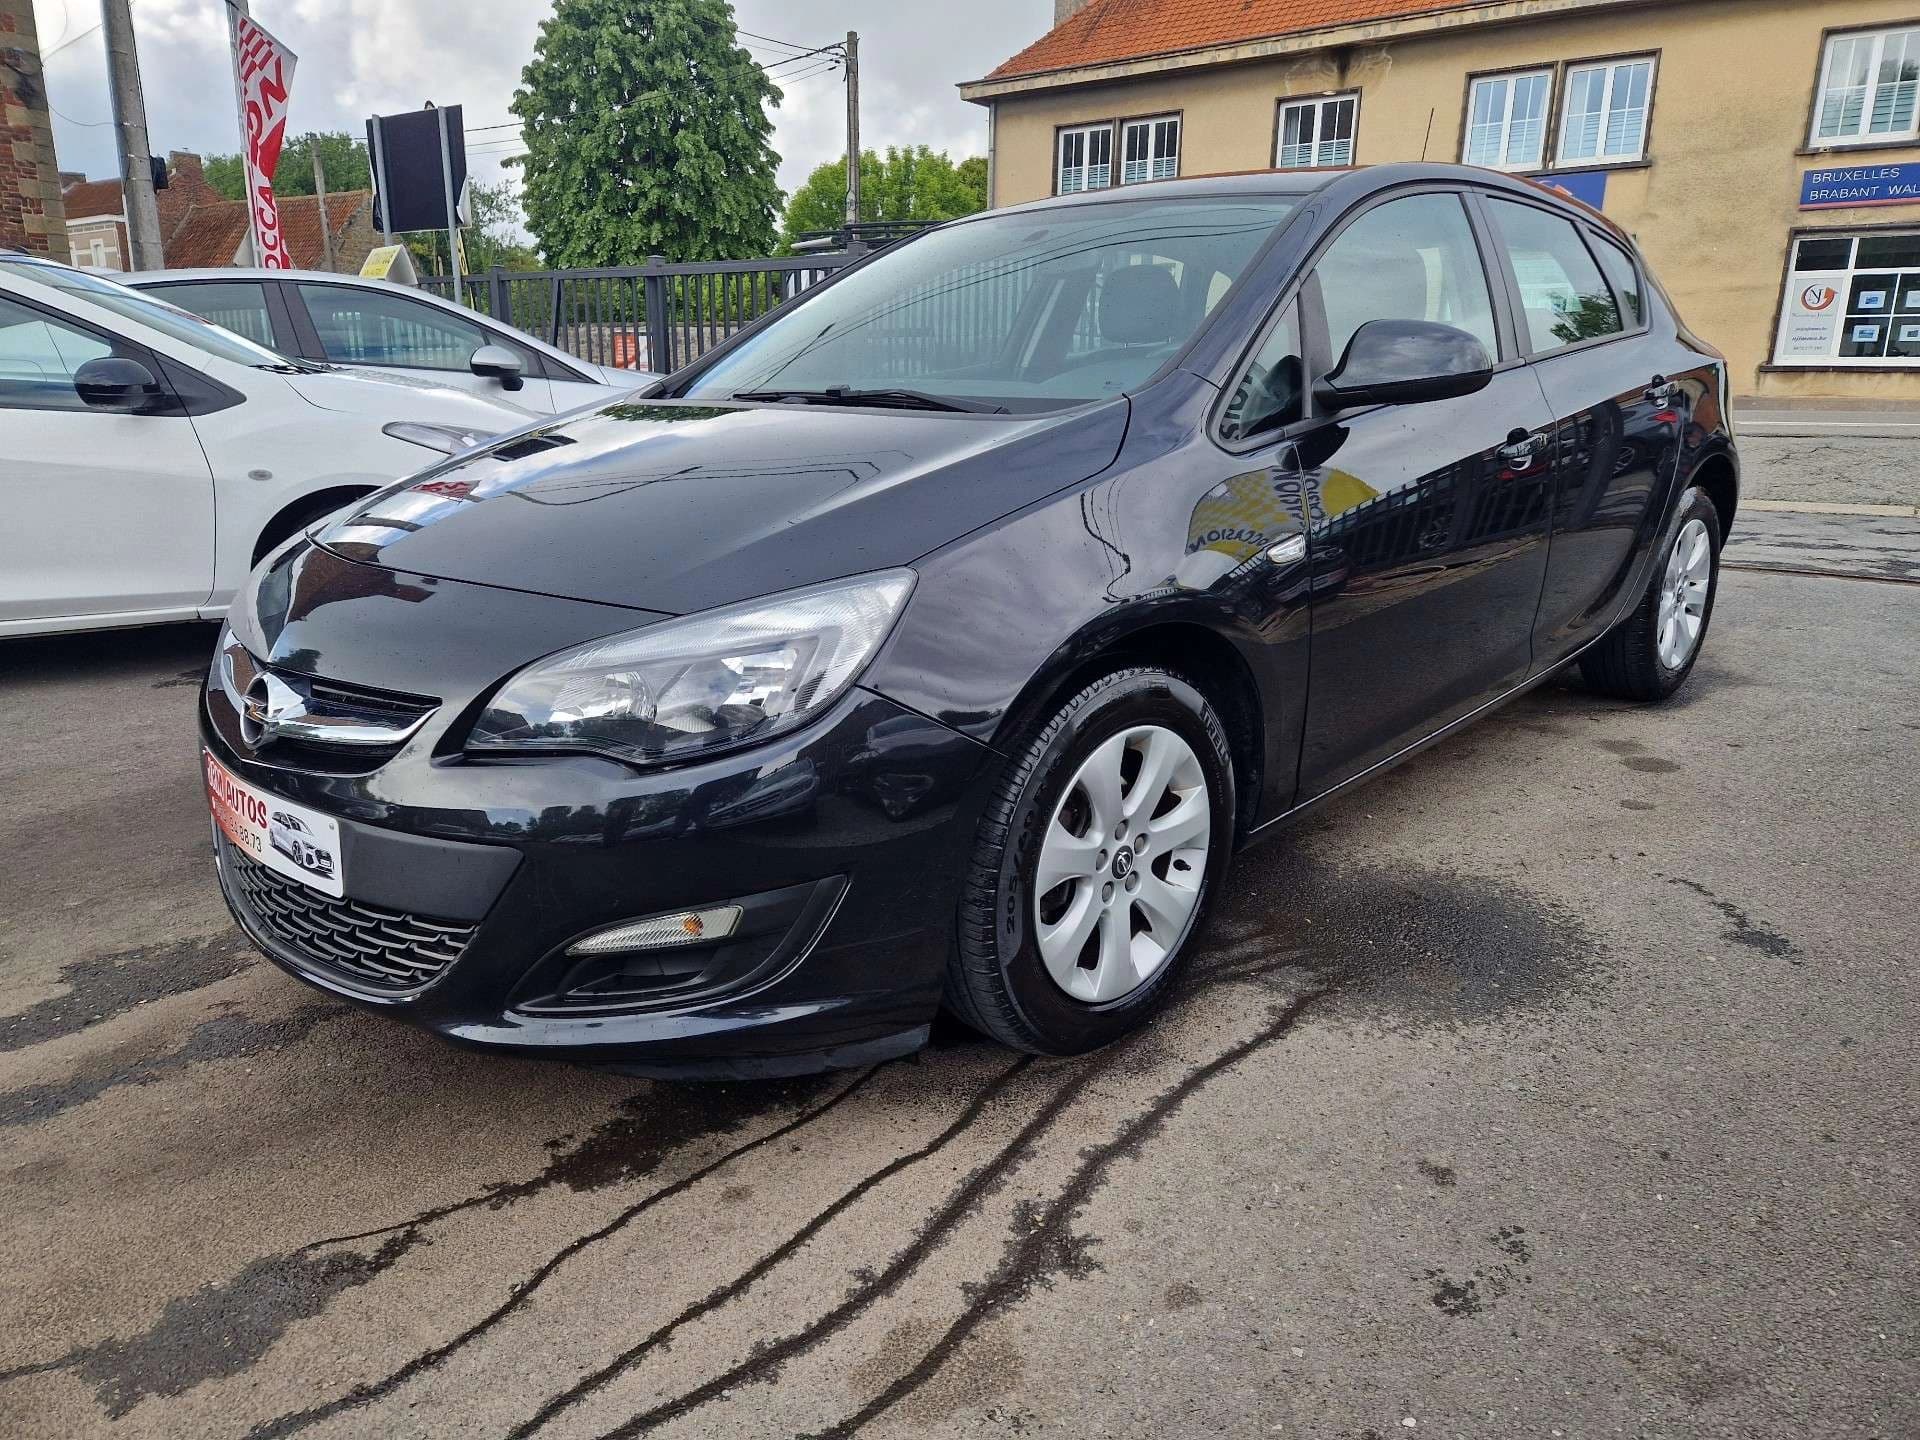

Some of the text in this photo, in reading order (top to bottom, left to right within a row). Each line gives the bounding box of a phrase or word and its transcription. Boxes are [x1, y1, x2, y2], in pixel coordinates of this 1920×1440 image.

[1812, 168, 1900, 184] BRUXELLES
[1809, 183, 1920, 201] BRABANT WAL
[226, 779, 267, 829] AUTOS
